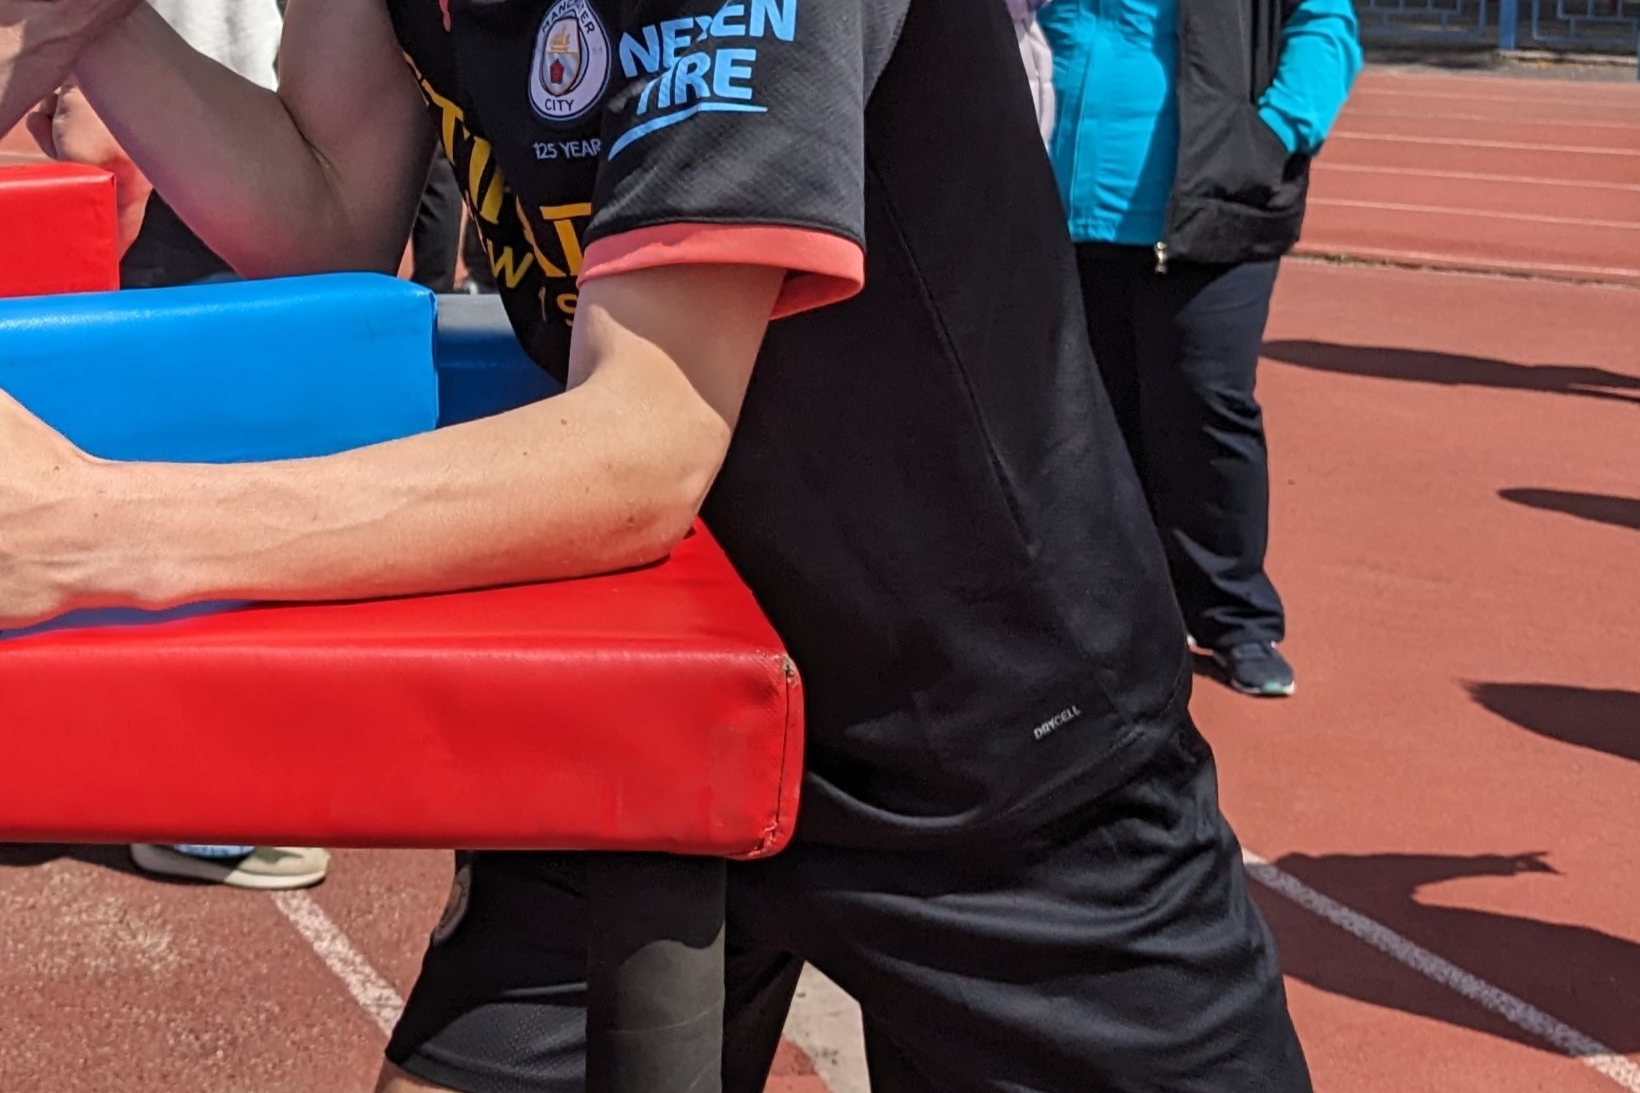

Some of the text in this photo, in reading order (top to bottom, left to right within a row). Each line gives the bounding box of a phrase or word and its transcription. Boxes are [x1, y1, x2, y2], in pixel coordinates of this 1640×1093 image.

[636, 48, 758, 116] TIRE
[544, 97, 575, 112] CITY
[533, 142, 558, 160] 125
[1033, 705, 1081, 741] DRYCELL
